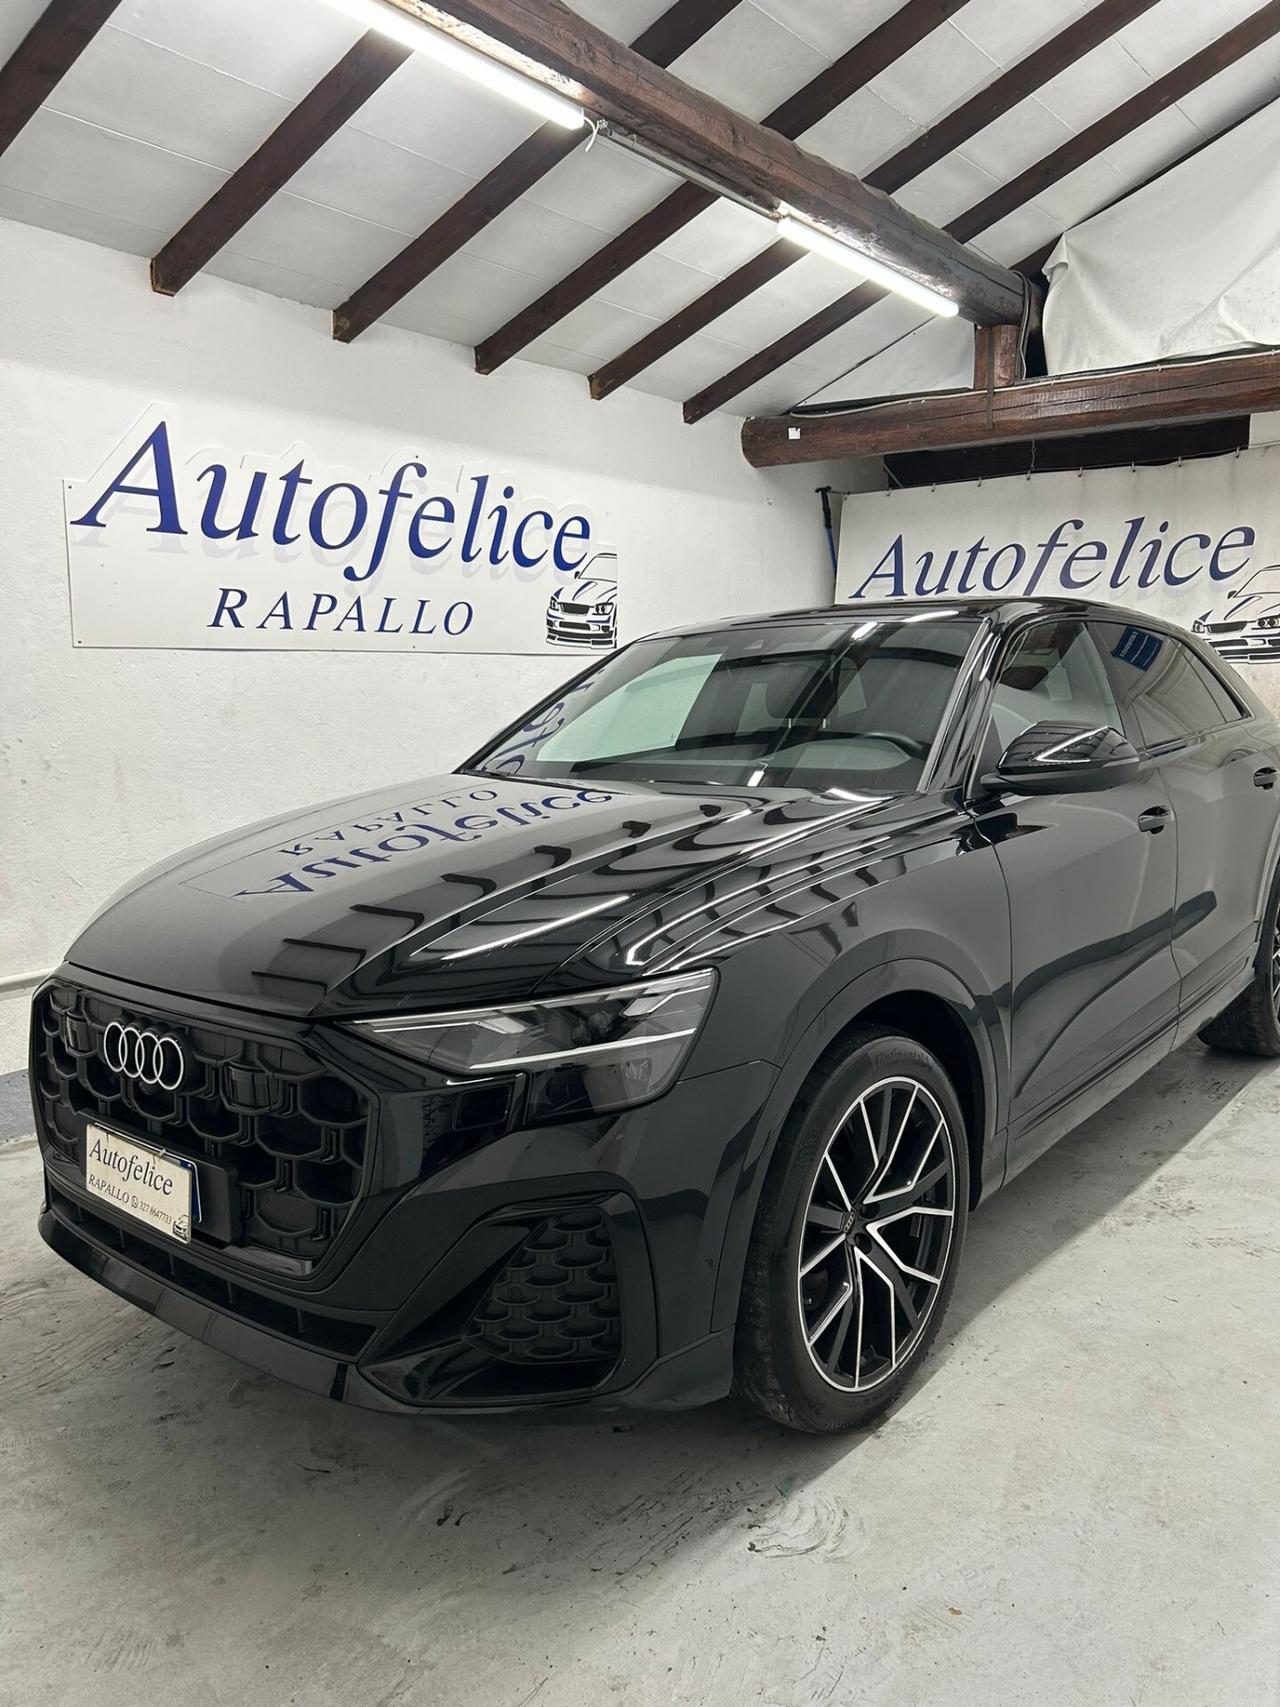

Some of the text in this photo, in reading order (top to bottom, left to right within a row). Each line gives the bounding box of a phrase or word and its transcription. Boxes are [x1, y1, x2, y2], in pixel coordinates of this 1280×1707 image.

[70, 420, 592, 581] Autofelice
[848, 516, 1256, 601] Autofelice
[206, 587, 474, 636] RAPALLO
[89, 1139, 173, 1195] Autofelice
[89, 1174, 129, 1203] RAPALLO
